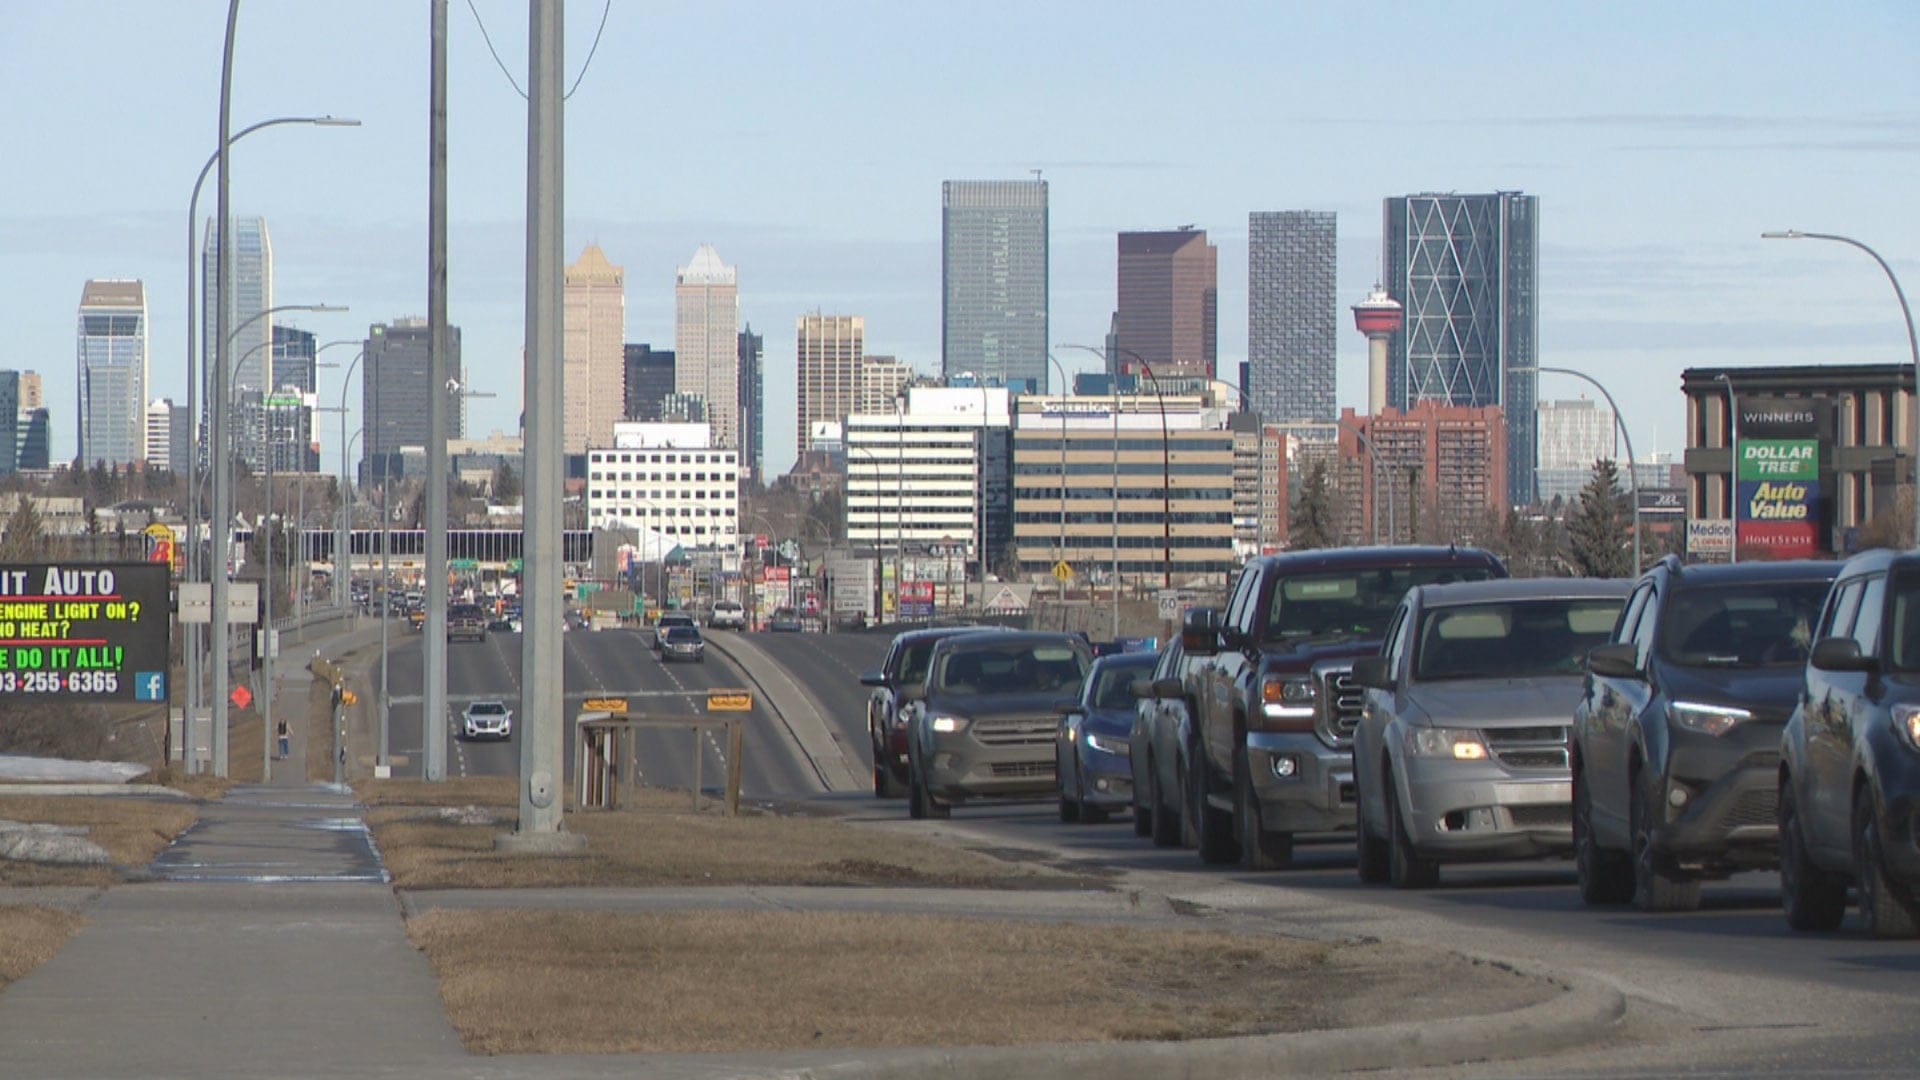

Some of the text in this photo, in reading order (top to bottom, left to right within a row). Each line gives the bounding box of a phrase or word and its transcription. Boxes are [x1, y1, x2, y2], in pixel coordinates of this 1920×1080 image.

[1744, 412, 1814, 423] WINNERS
[1745, 446, 1813, 459] DOLLAR
[1757, 461, 1800, 473] TREE
[1754, 481, 1807, 501] Auto
[1750, 500, 1807, 519] Value
[43, 566, 114, 595] AUTO
[0, 603, 48, 620] ENGINE
[55, 603, 99, 619] LIGHT
[1160, 598, 1177, 611] 60
[20, 620, 70, 639] HEAT?
[16, 647, 42, 668] DO
[51, 647, 71, 668] IT
[76, 646, 123, 671] ALL!
